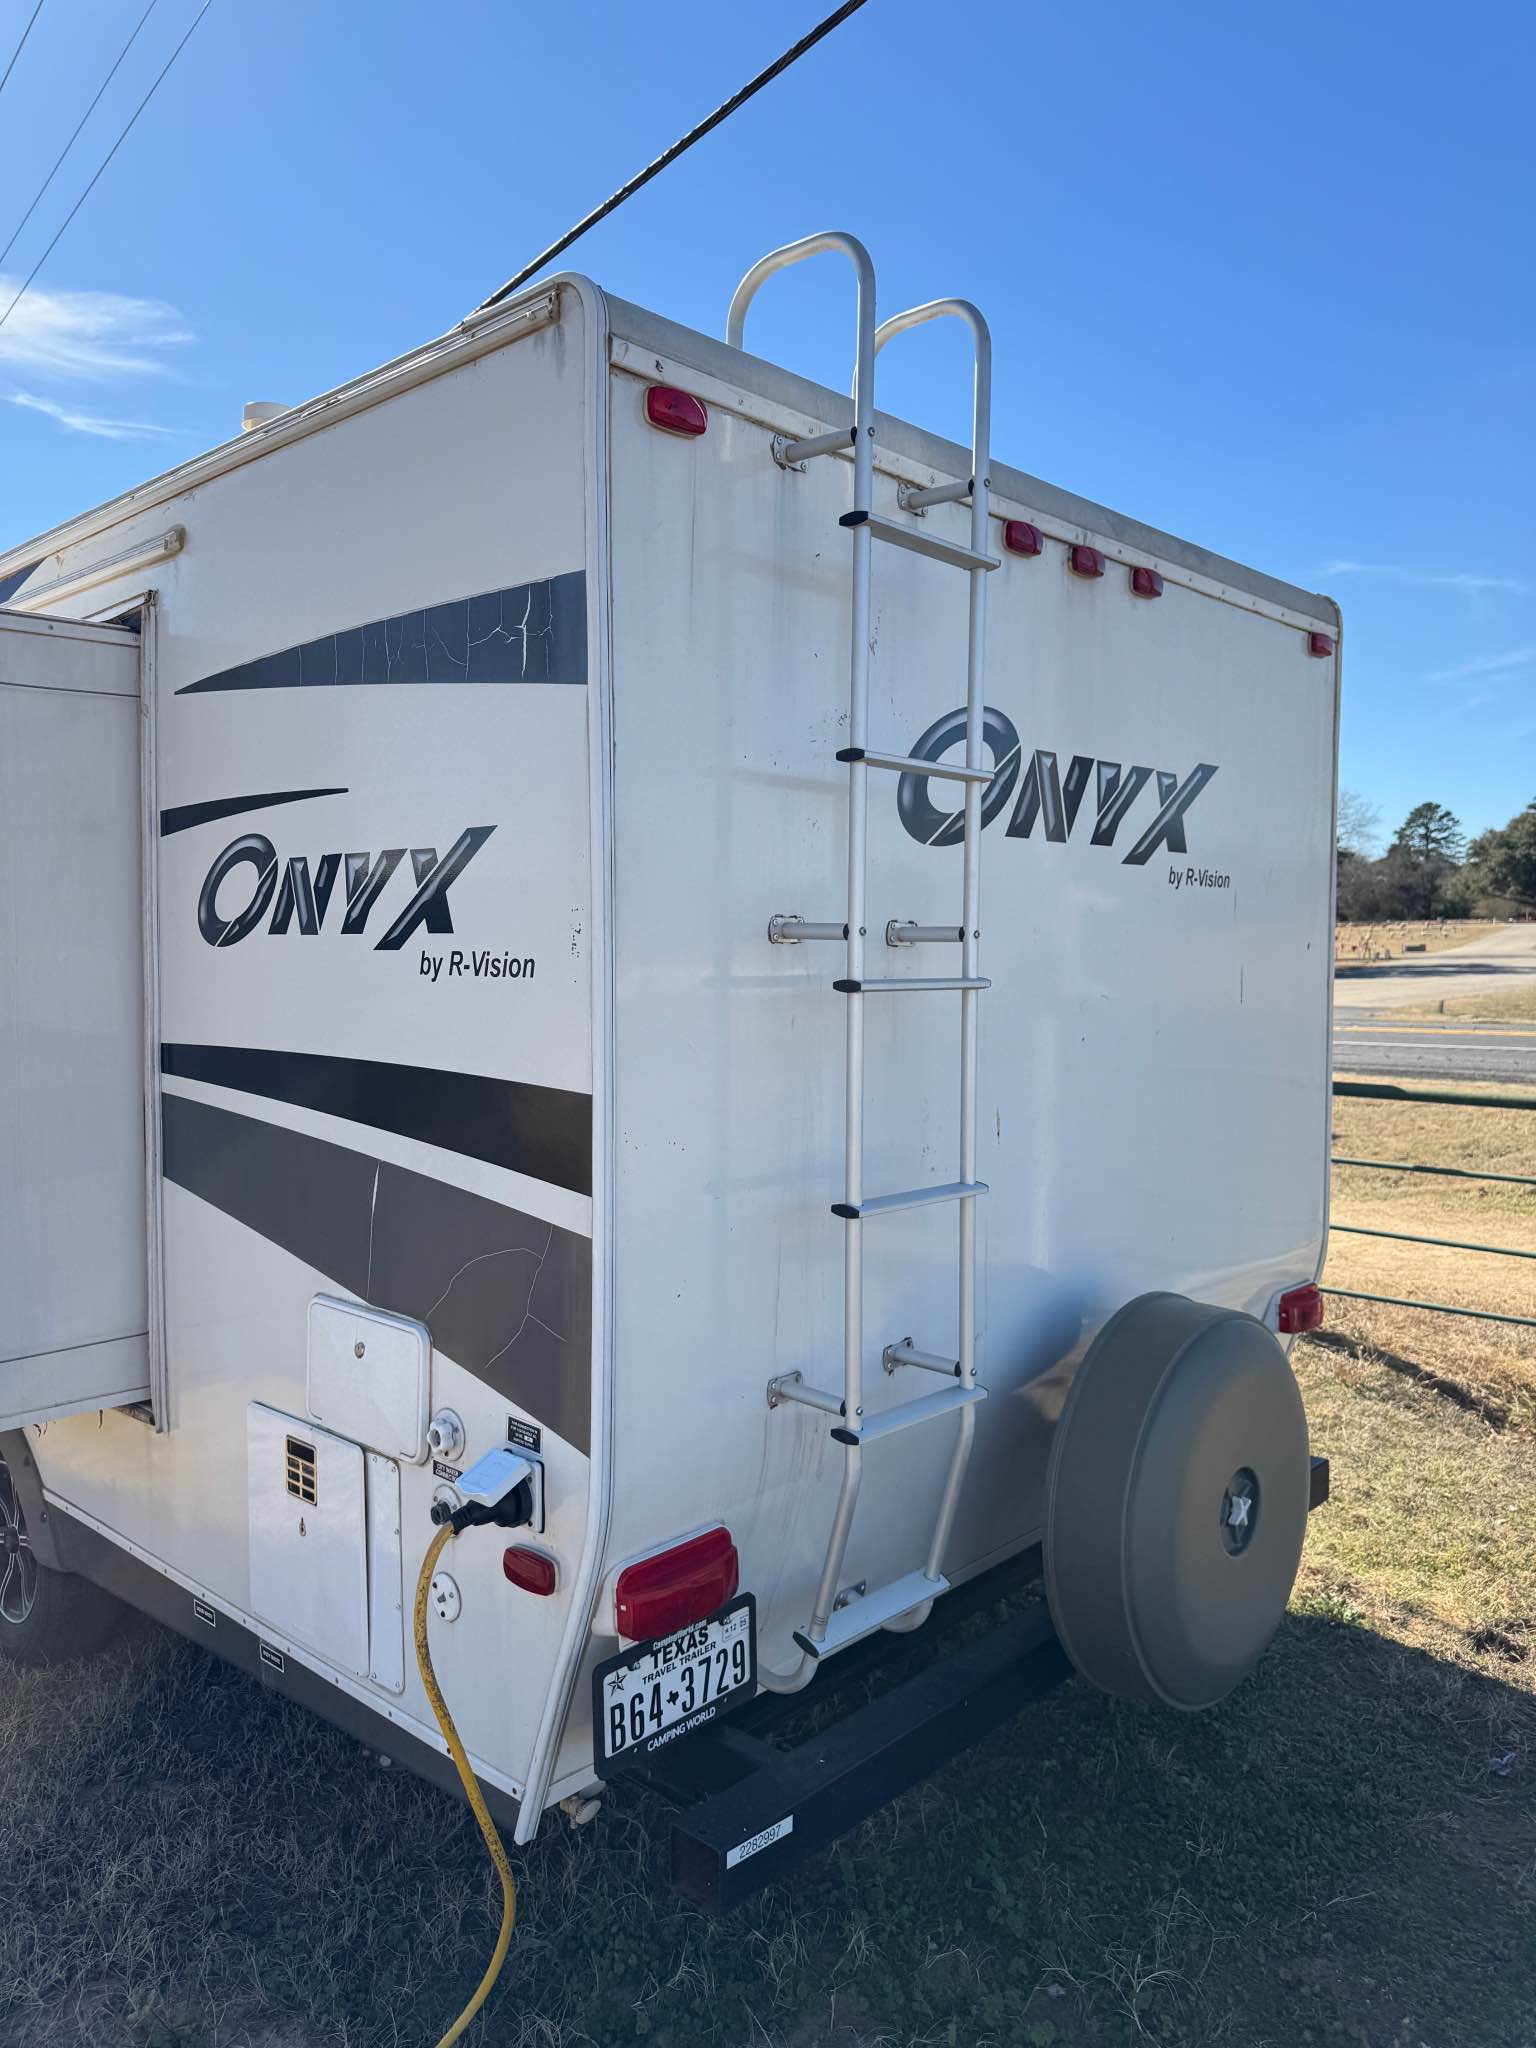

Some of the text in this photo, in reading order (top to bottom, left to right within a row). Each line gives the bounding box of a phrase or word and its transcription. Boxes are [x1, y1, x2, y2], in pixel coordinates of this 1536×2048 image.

[897, 705, 1219, 865] ONYX
[197, 824, 498, 950] ONYX
[1168, 866, 1230, 889] by R-Vision
[420, 950, 535, 982] by R-Vision
[642, 1641, 717, 1685] TRAVEL TRAILER
[650, 1626, 709, 1669] TEXAS
[610, 1639, 746, 1754] B64 3729
[647, 1706, 716, 1751] CAMPING WORLD
[740, 1824, 782, 1860] 2282997
